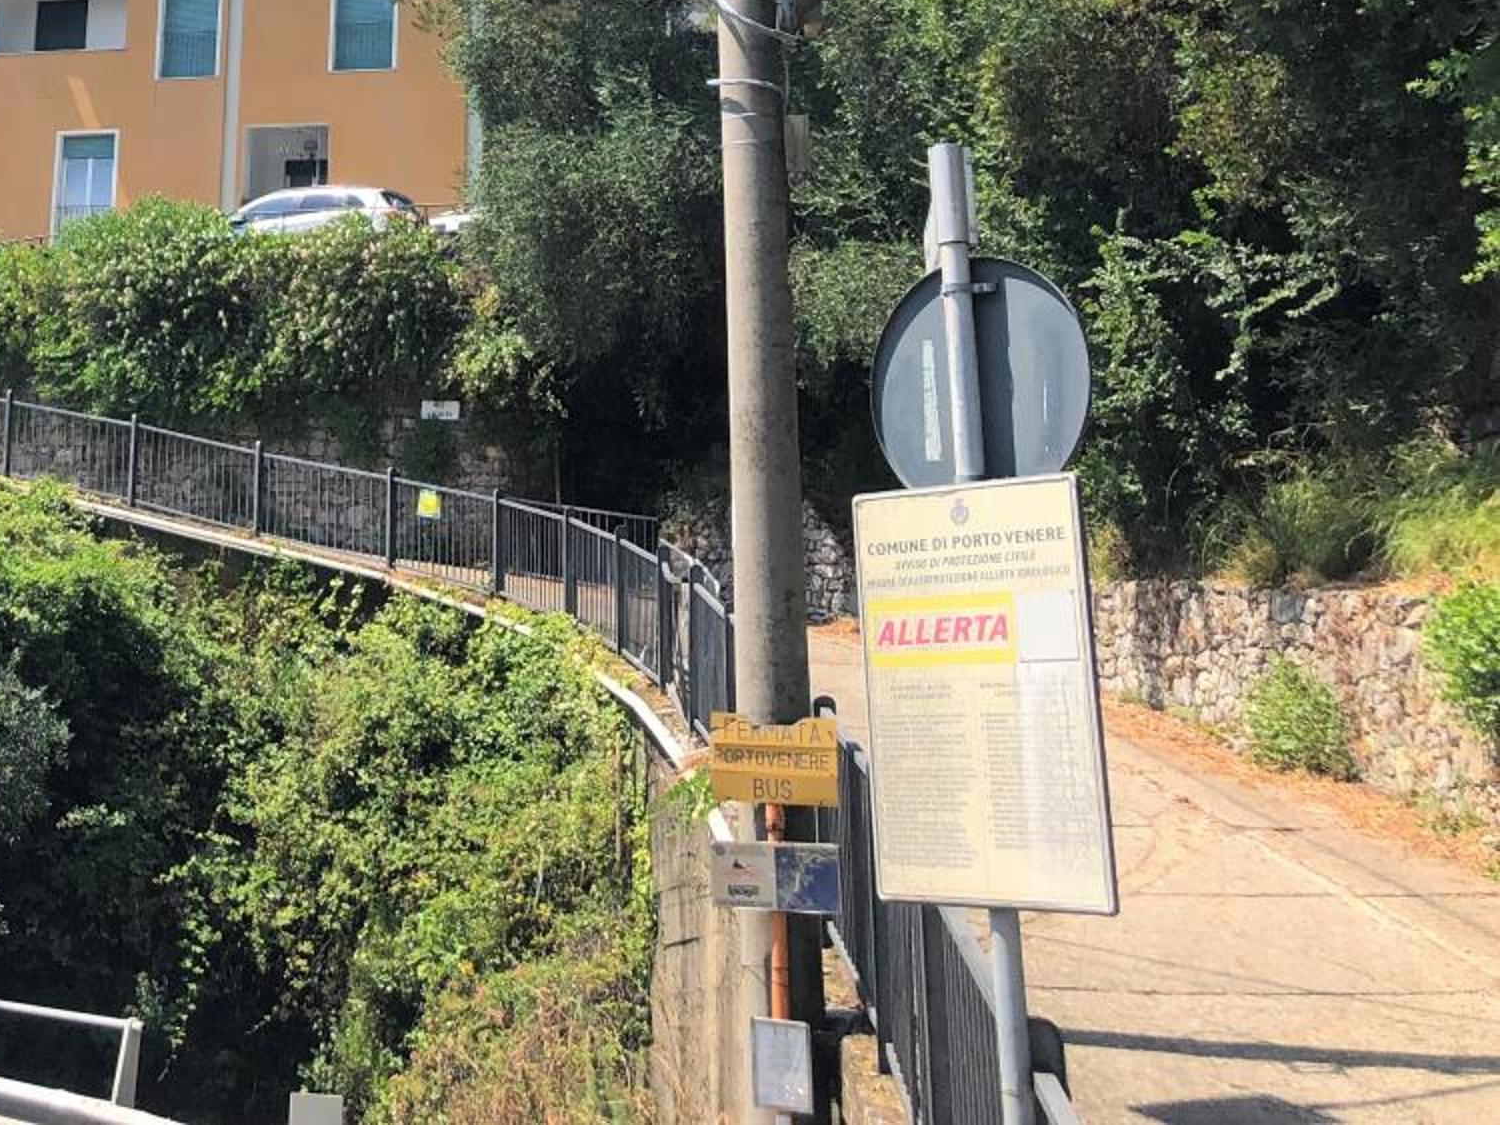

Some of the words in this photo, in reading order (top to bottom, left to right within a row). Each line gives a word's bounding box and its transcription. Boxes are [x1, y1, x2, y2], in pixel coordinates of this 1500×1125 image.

[867, 538, 928, 556] COMUNE
[932, 538, 947, 552] DI
[952, 532, 1002, 549] PORTO
[1004, 526, 1066, 544] VENERE
[877, 614, 1008, 646] ALLERTA
[753, 778, 793, 800] BUS
